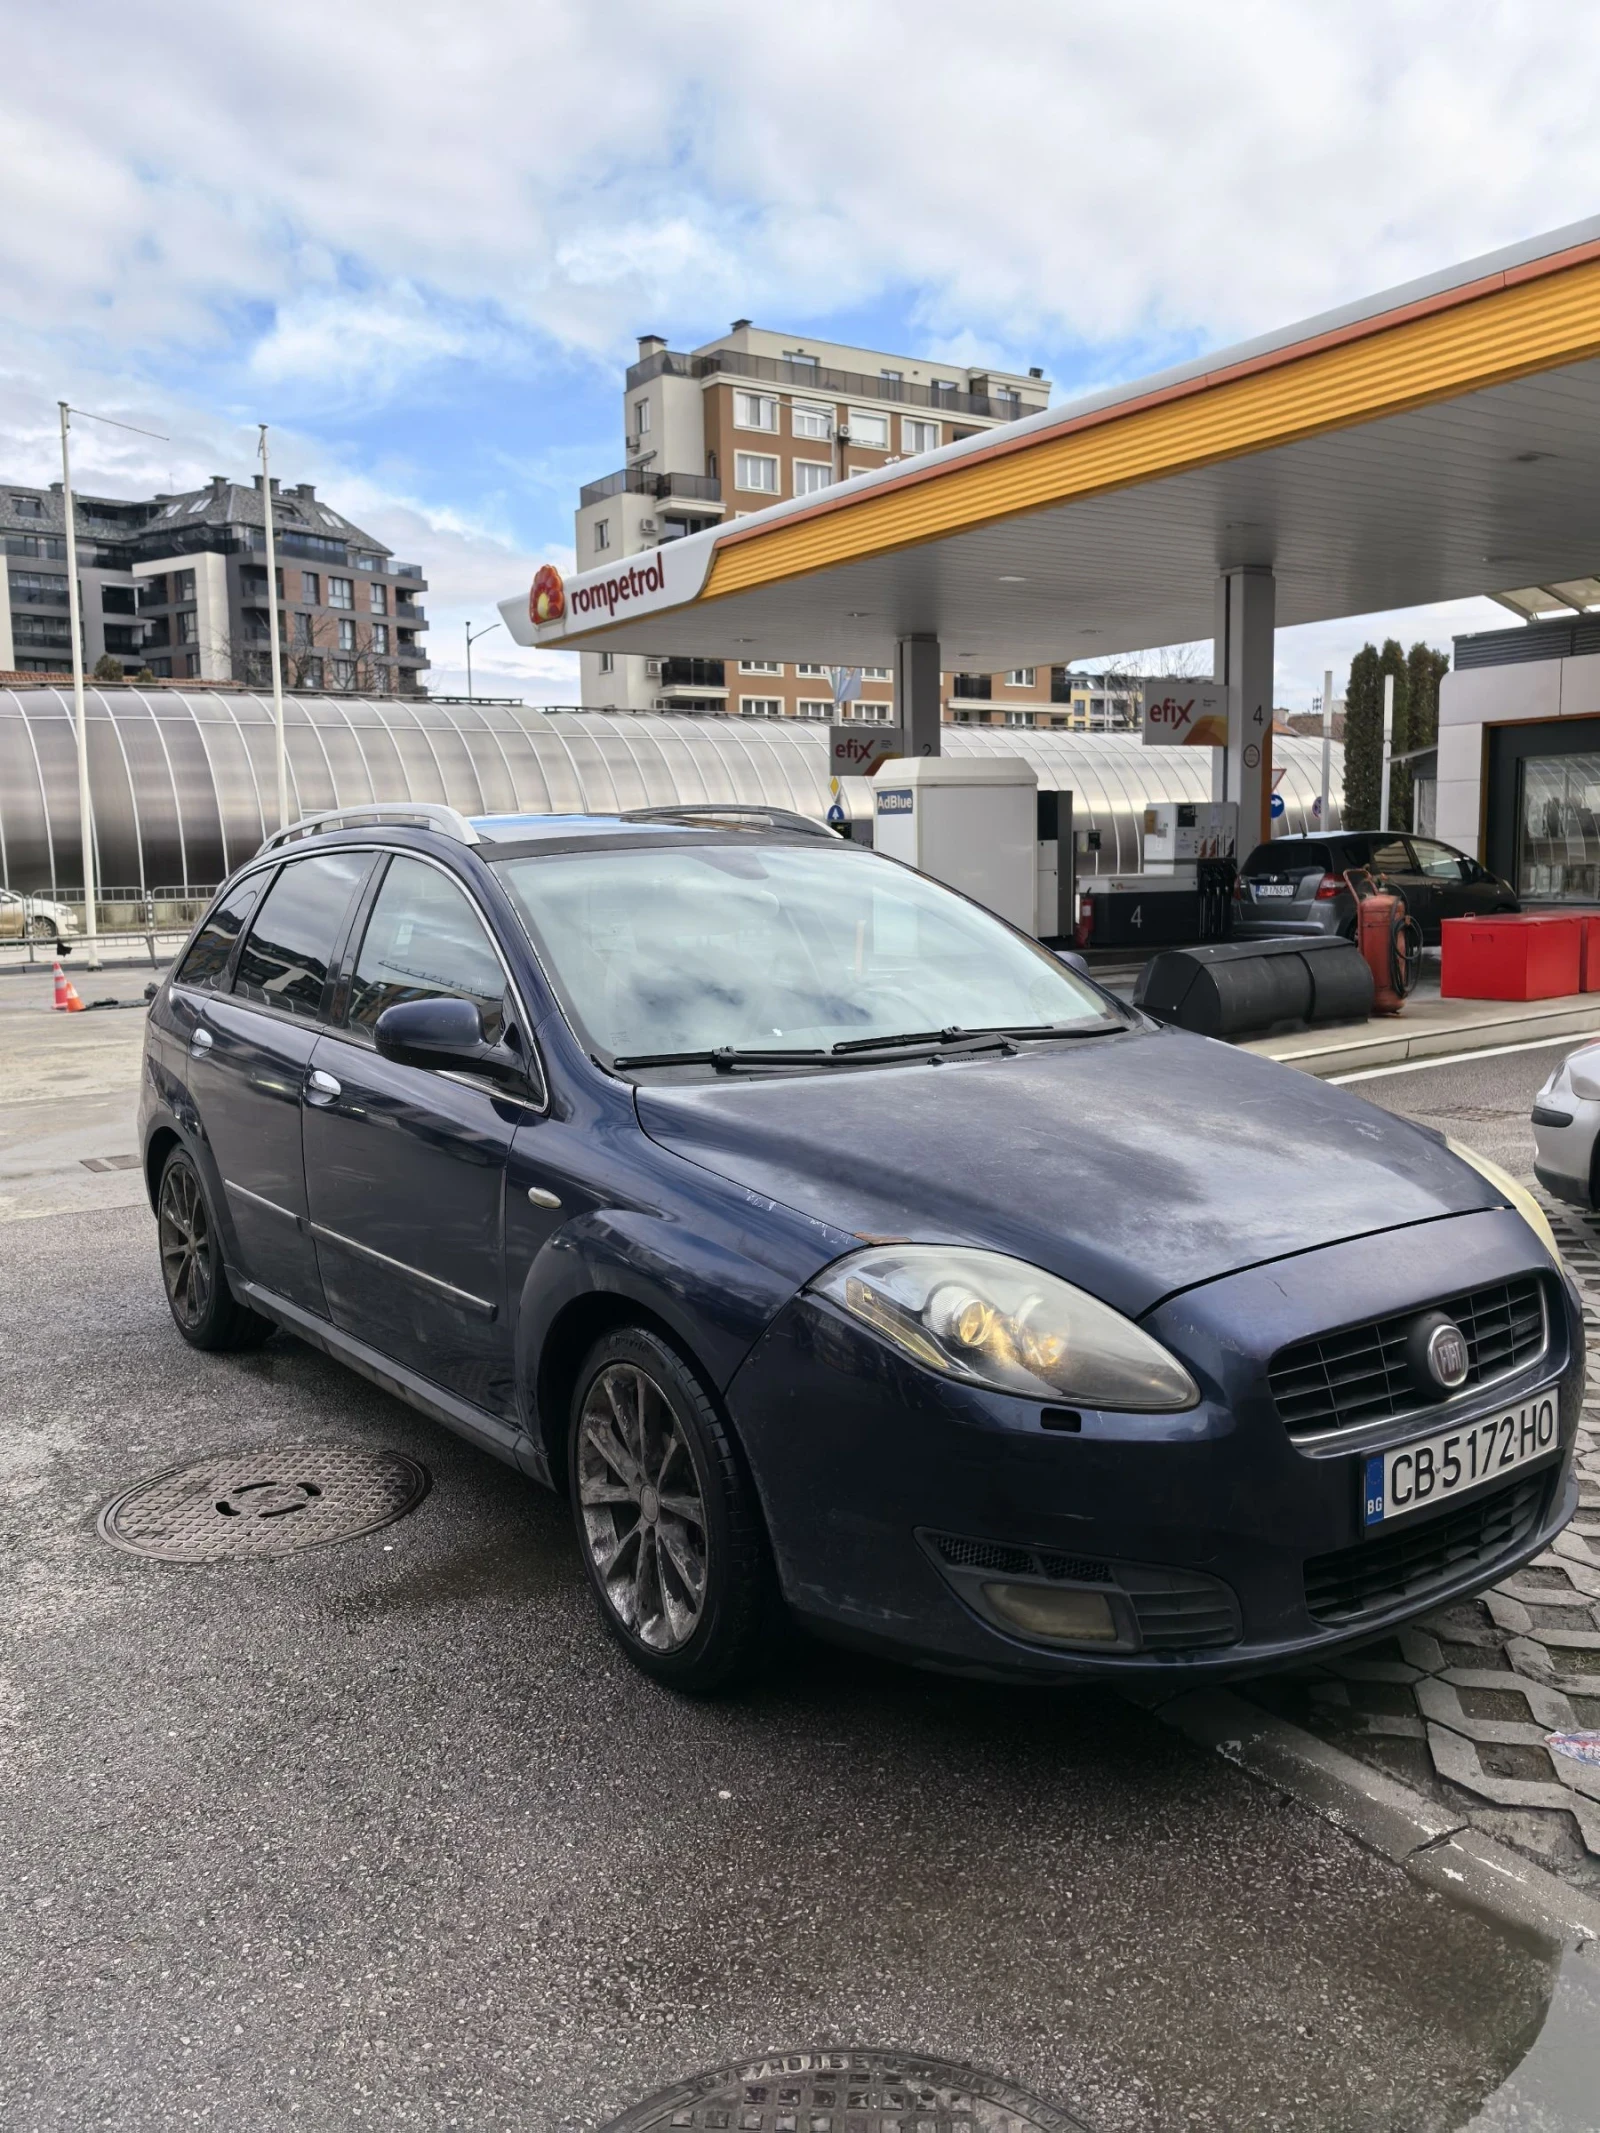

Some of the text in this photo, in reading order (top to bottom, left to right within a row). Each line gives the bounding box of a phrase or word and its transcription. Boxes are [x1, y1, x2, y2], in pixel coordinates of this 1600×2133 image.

[571, 551, 665, 617] rompetrol
[1149, 697, 1196, 730] efix
[1253, 705, 1264, 726] 4
[835, 738, 875, 764] efix
[878, 794, 912, 810] AdBlue
[1130, 905, 1143, 928] 4
[1438, 1341, 1462, 1374] FIAT
[1367, 1496, 1383, 1517] BG
